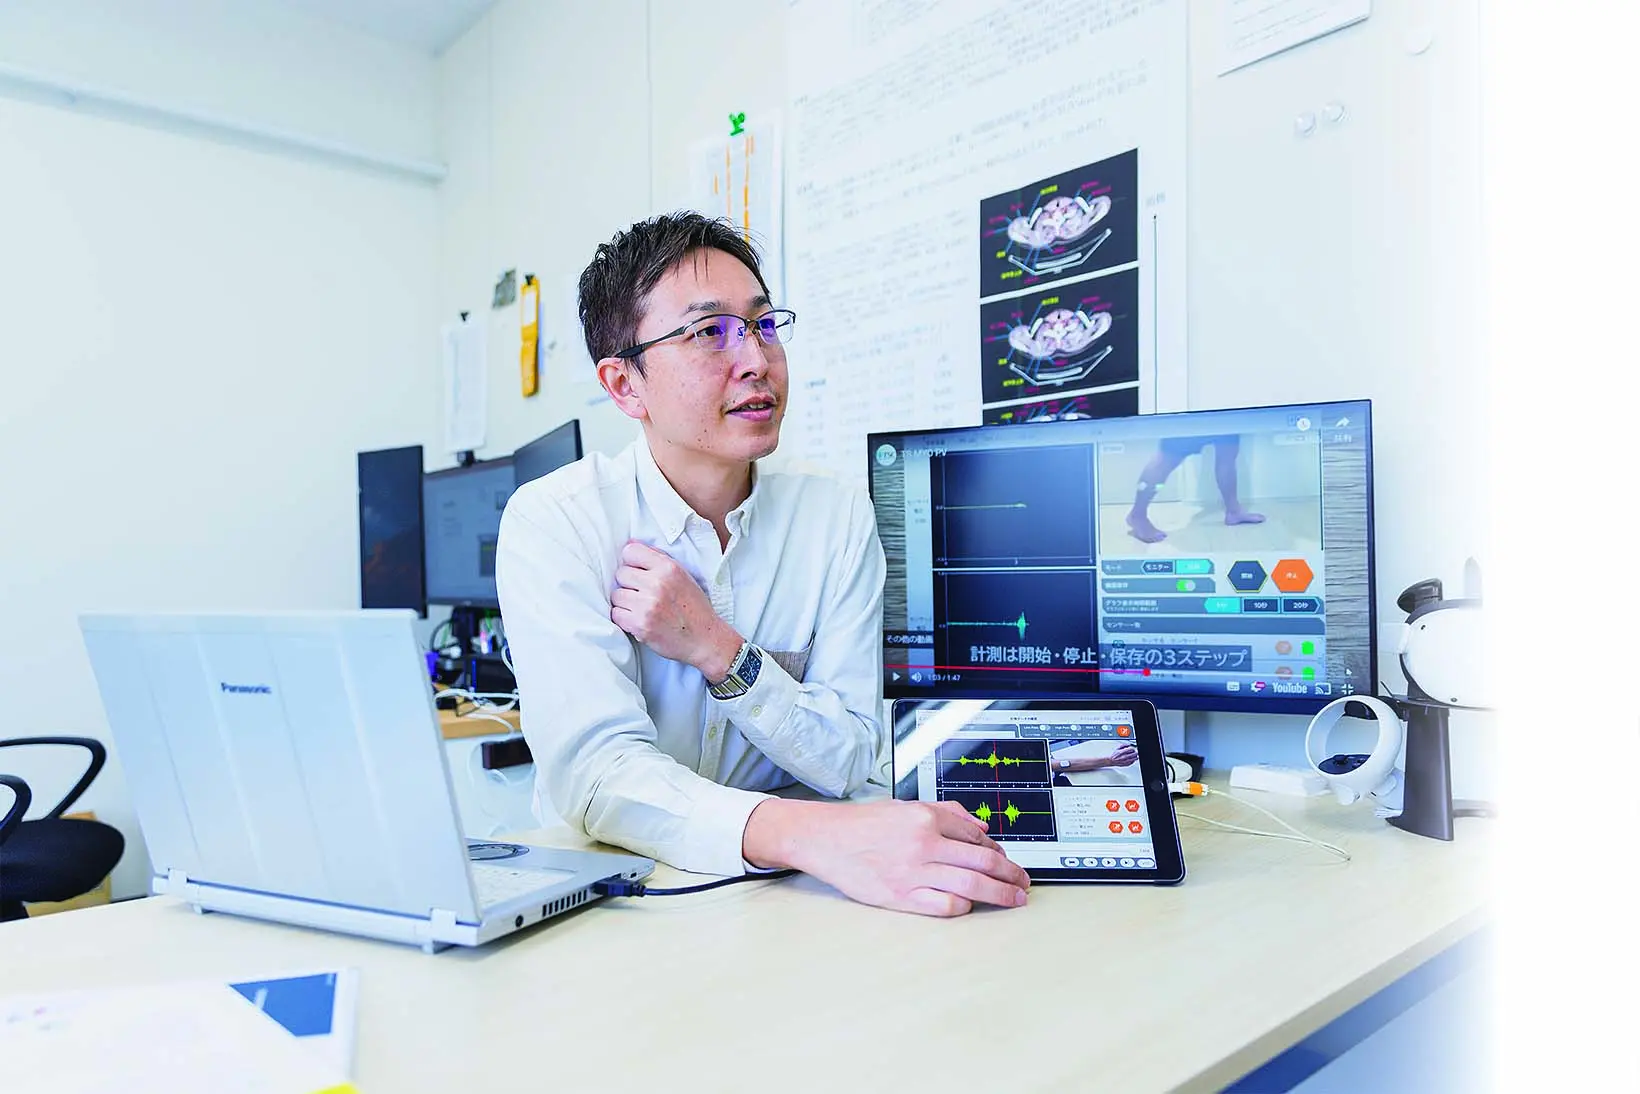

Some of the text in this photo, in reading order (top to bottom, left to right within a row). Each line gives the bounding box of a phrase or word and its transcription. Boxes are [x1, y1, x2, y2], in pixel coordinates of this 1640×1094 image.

[1253, 601, 1268, 609] 10秒
[1292, 601, 1310, 610] 20秒
[886, 634, 934, 645] その他の動画
[970, 645, 1248, 667] 計測は開始・停止・保存の3ステップ
[220, 682, 272, 694] Panasonic
[1271, 682, 1308, 694] YouTube
